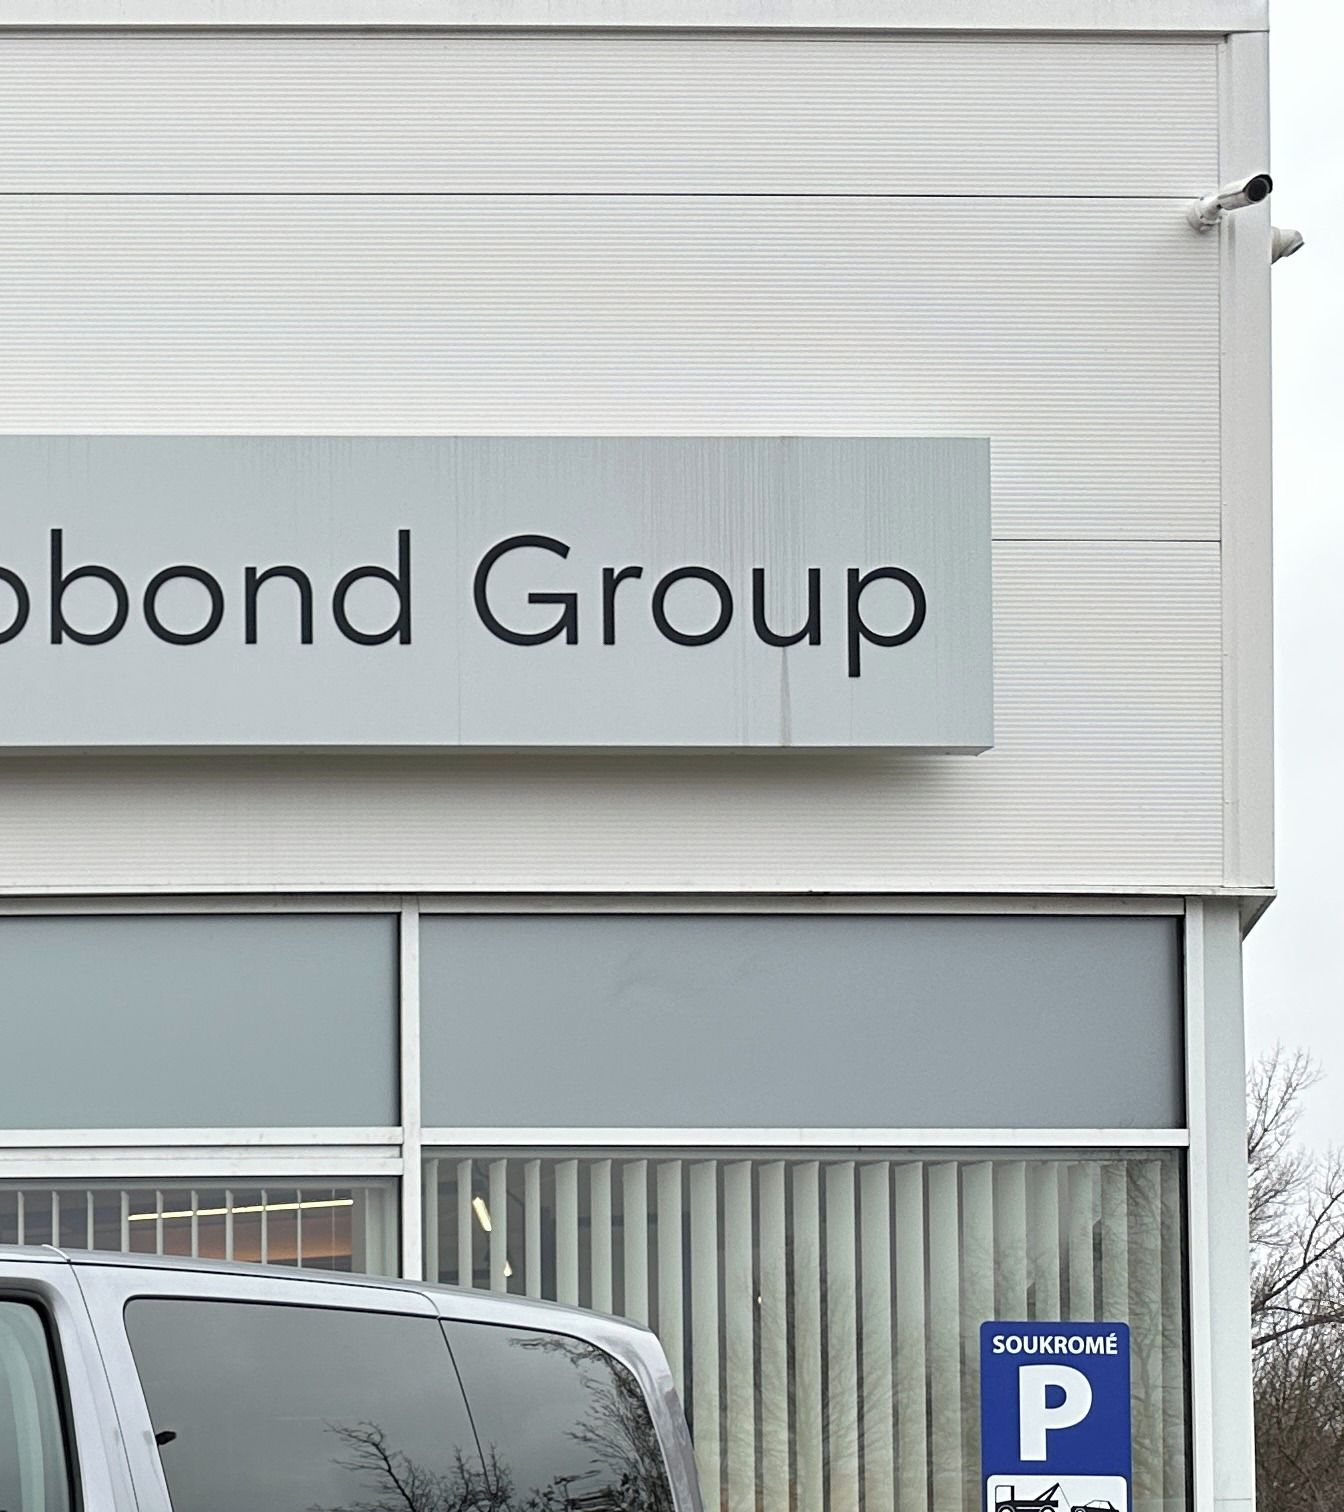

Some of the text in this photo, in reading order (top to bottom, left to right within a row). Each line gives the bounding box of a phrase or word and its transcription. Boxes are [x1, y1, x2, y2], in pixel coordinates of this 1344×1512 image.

[473, 534, 929, 680] Group
[992, 1332, 1118, 1355] SOUKROMÉ
[1018, 1364, 1093, 1462] P
